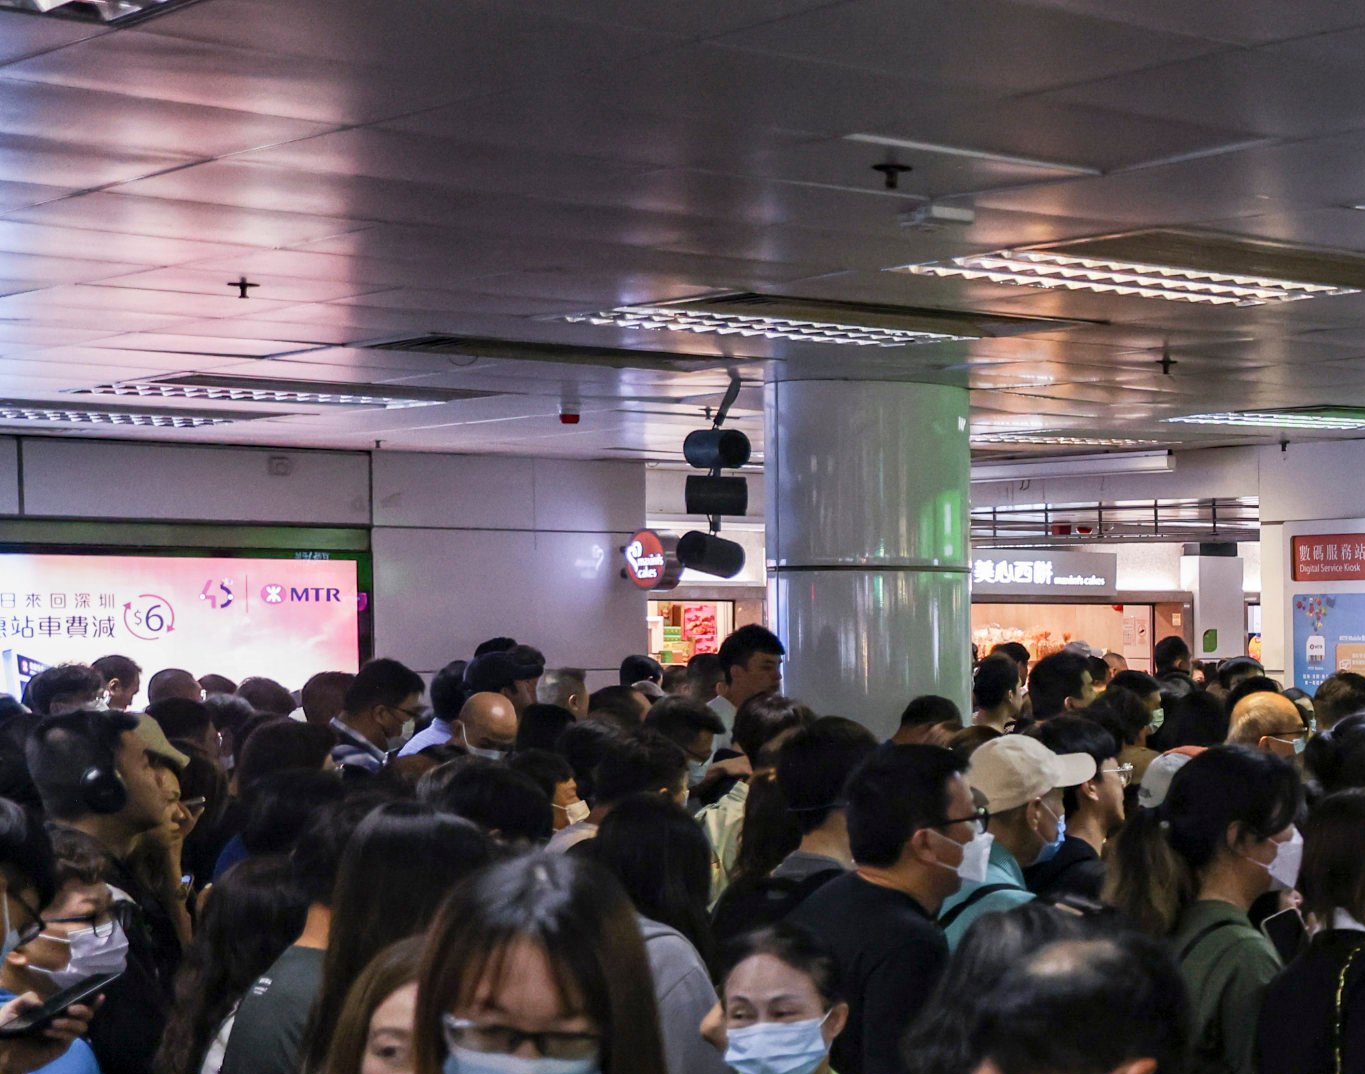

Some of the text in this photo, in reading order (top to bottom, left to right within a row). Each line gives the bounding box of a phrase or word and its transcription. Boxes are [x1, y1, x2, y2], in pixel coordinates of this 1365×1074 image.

[1299, 543, 1365, 561] 數碼服務站
[1300, 563, 1360, 574] Digital Service Kiosk
[0, 592, 115, 609] 日來回深圳
[290, 587, 341, 602] MTR
[134, 604, 164, 632] $6
